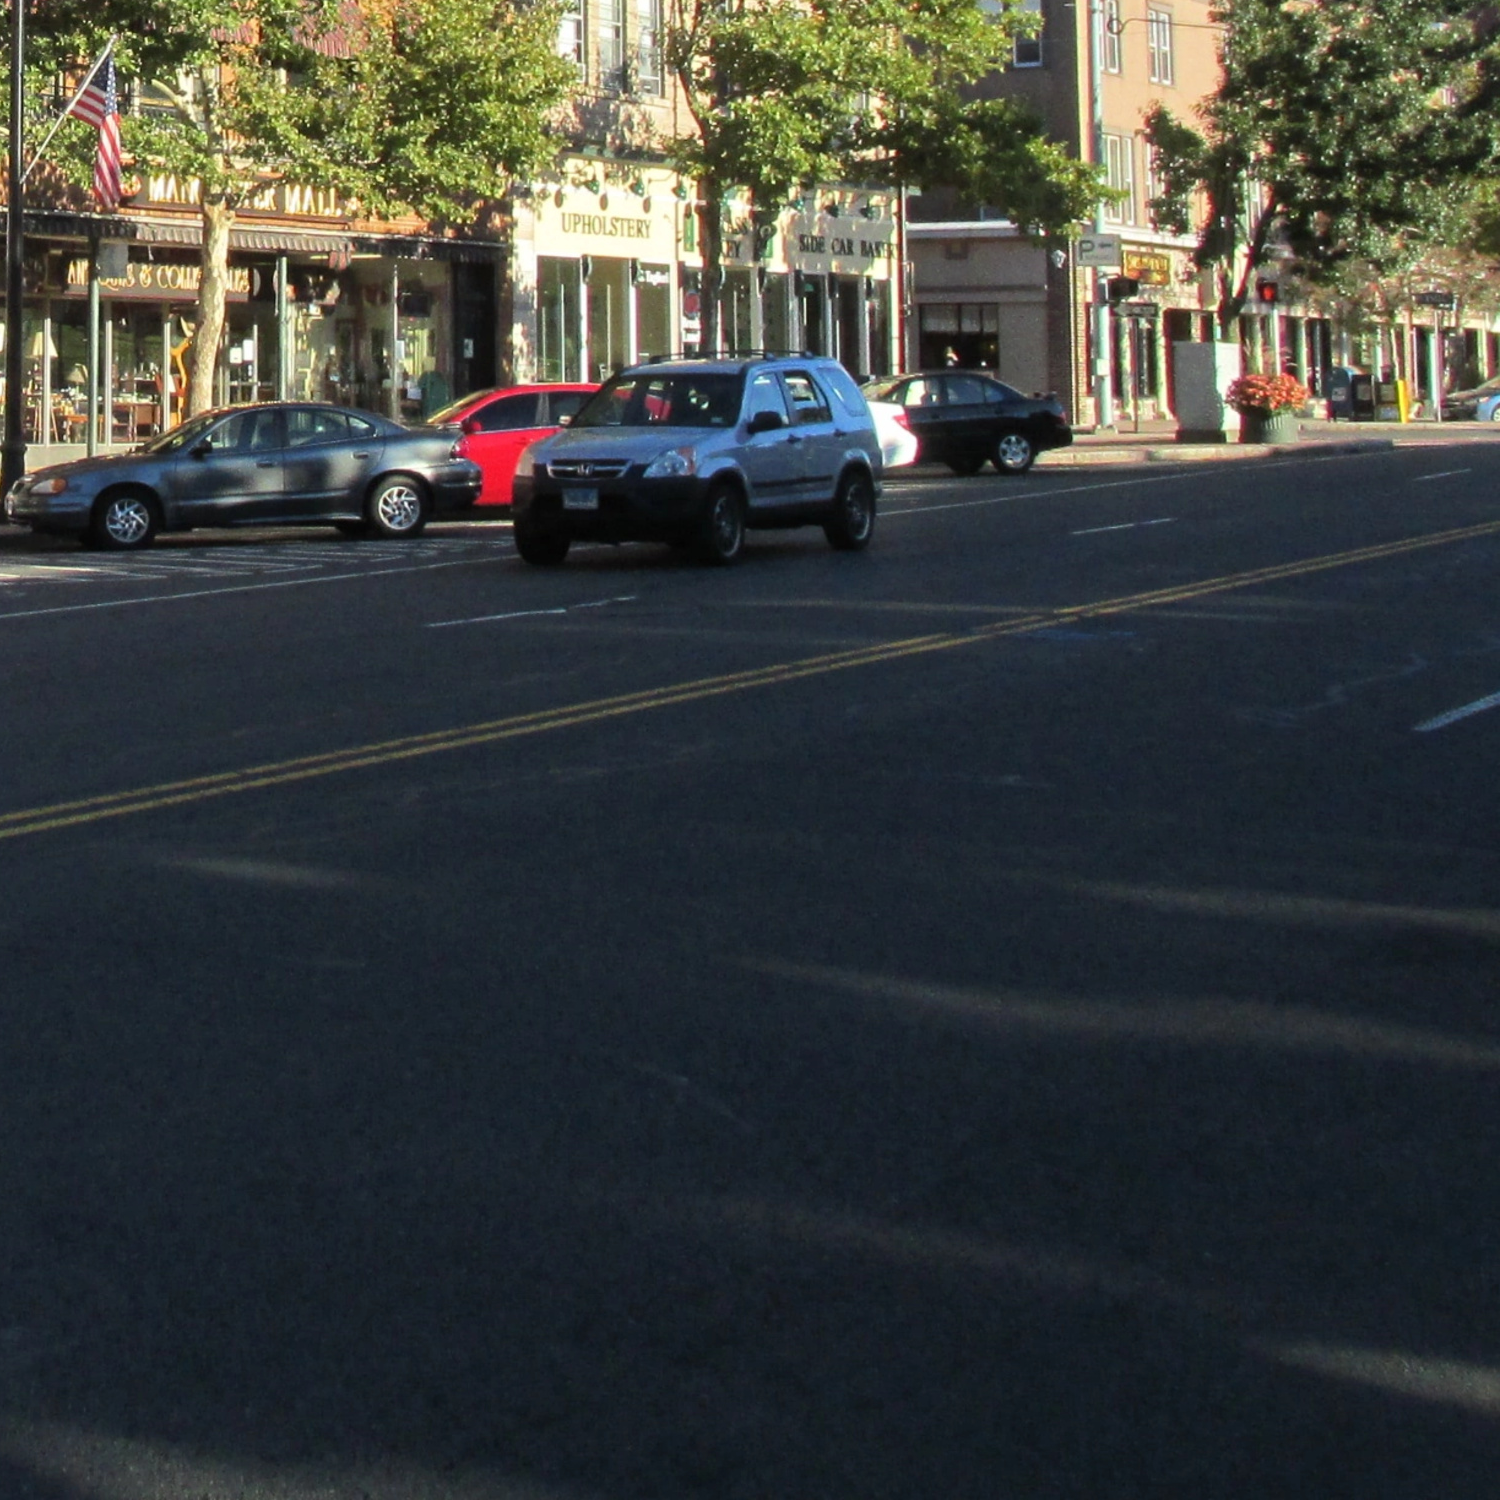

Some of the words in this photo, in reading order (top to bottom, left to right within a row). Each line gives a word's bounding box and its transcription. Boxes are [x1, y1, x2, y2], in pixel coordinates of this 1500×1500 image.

[284, 183, 342, 217] MALL
[561, 211, 652, 239] UPHOLSTERY
[800, 233, 826, 254] SIDE
[831, 237, 854, 256] CAR
